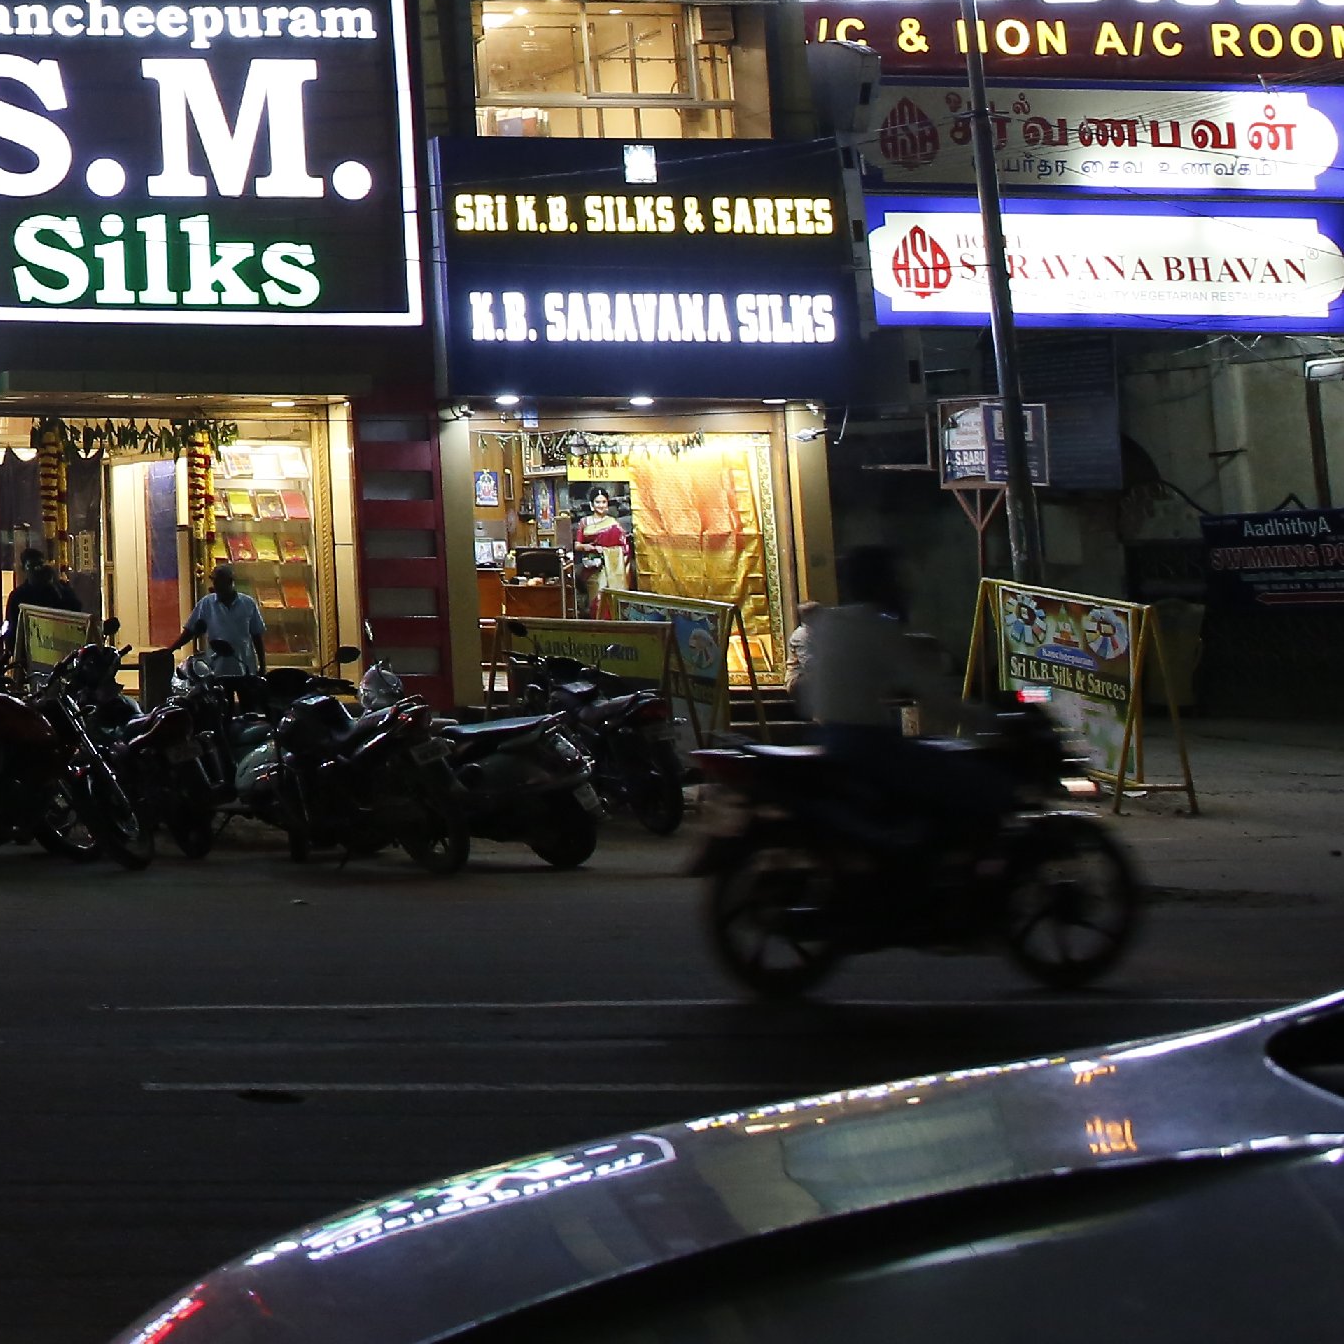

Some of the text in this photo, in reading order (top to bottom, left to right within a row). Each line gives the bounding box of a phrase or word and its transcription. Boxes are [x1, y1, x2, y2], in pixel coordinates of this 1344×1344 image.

[898, 18, 929, 53] &
[1095, 22, 1183, 57] A/C
[456, 194, 833, 234] SRI K.B. SILKS & SAREES
[13, 213, 321, 308] Silks
[1163, 256, 1308, 285] BHAVAN
[470, 292, 835, 343] K.B. SARAVANA SILKS
[1010, 655, 1026, 678] Sri
[1053, 664, 1073, 688] Silk
[1075, 669, 1086, 692] &
[1088, 673, 1127, 701] Sarees
